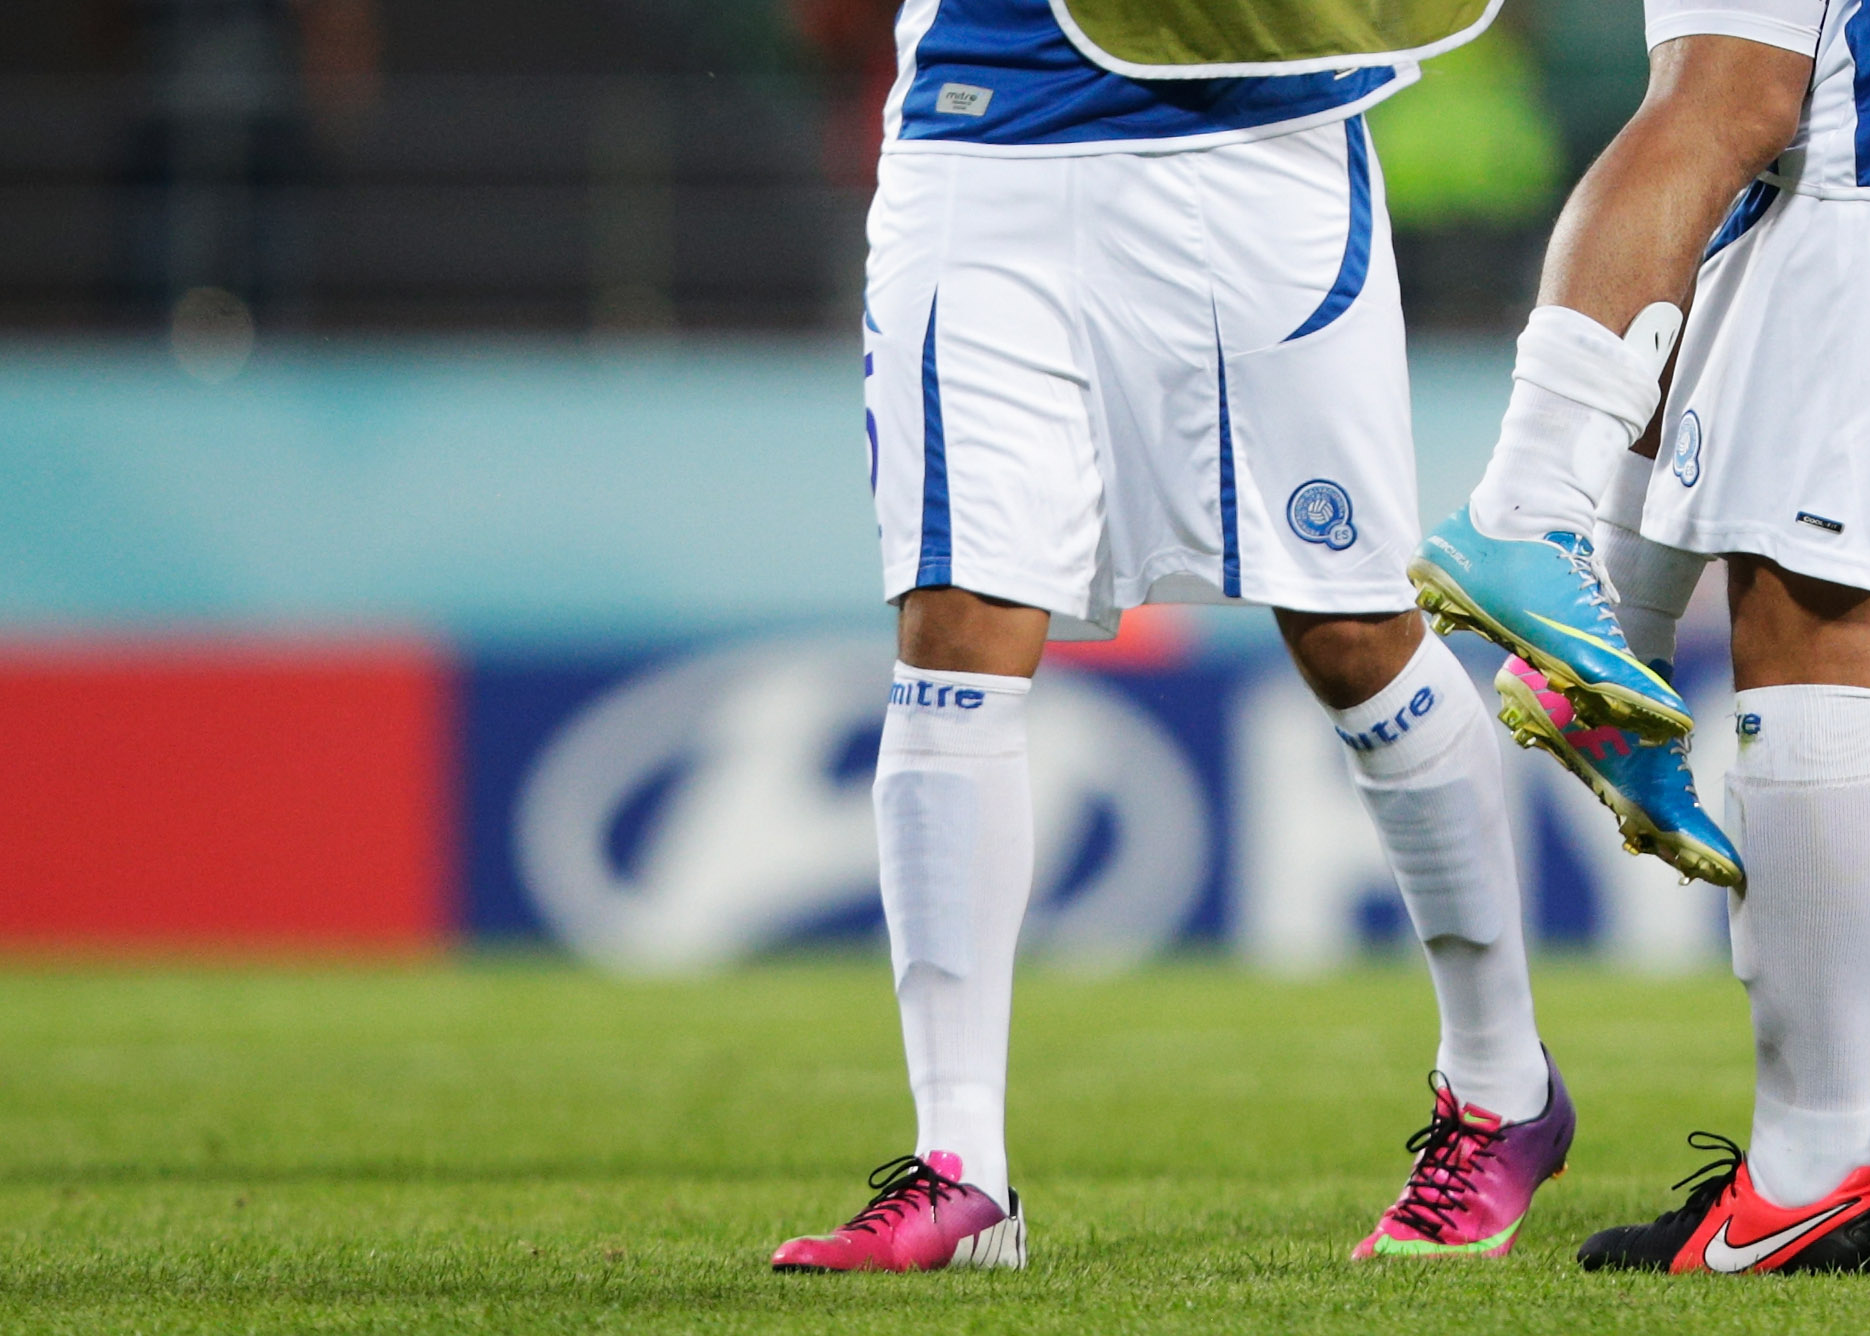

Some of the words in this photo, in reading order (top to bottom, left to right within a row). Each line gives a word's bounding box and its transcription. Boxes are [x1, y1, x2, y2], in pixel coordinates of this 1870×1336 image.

[945, 91, 978, 102] mitre
[1335, 529, 1350, 541] ES
[888, 680, 985, 710] mitre
